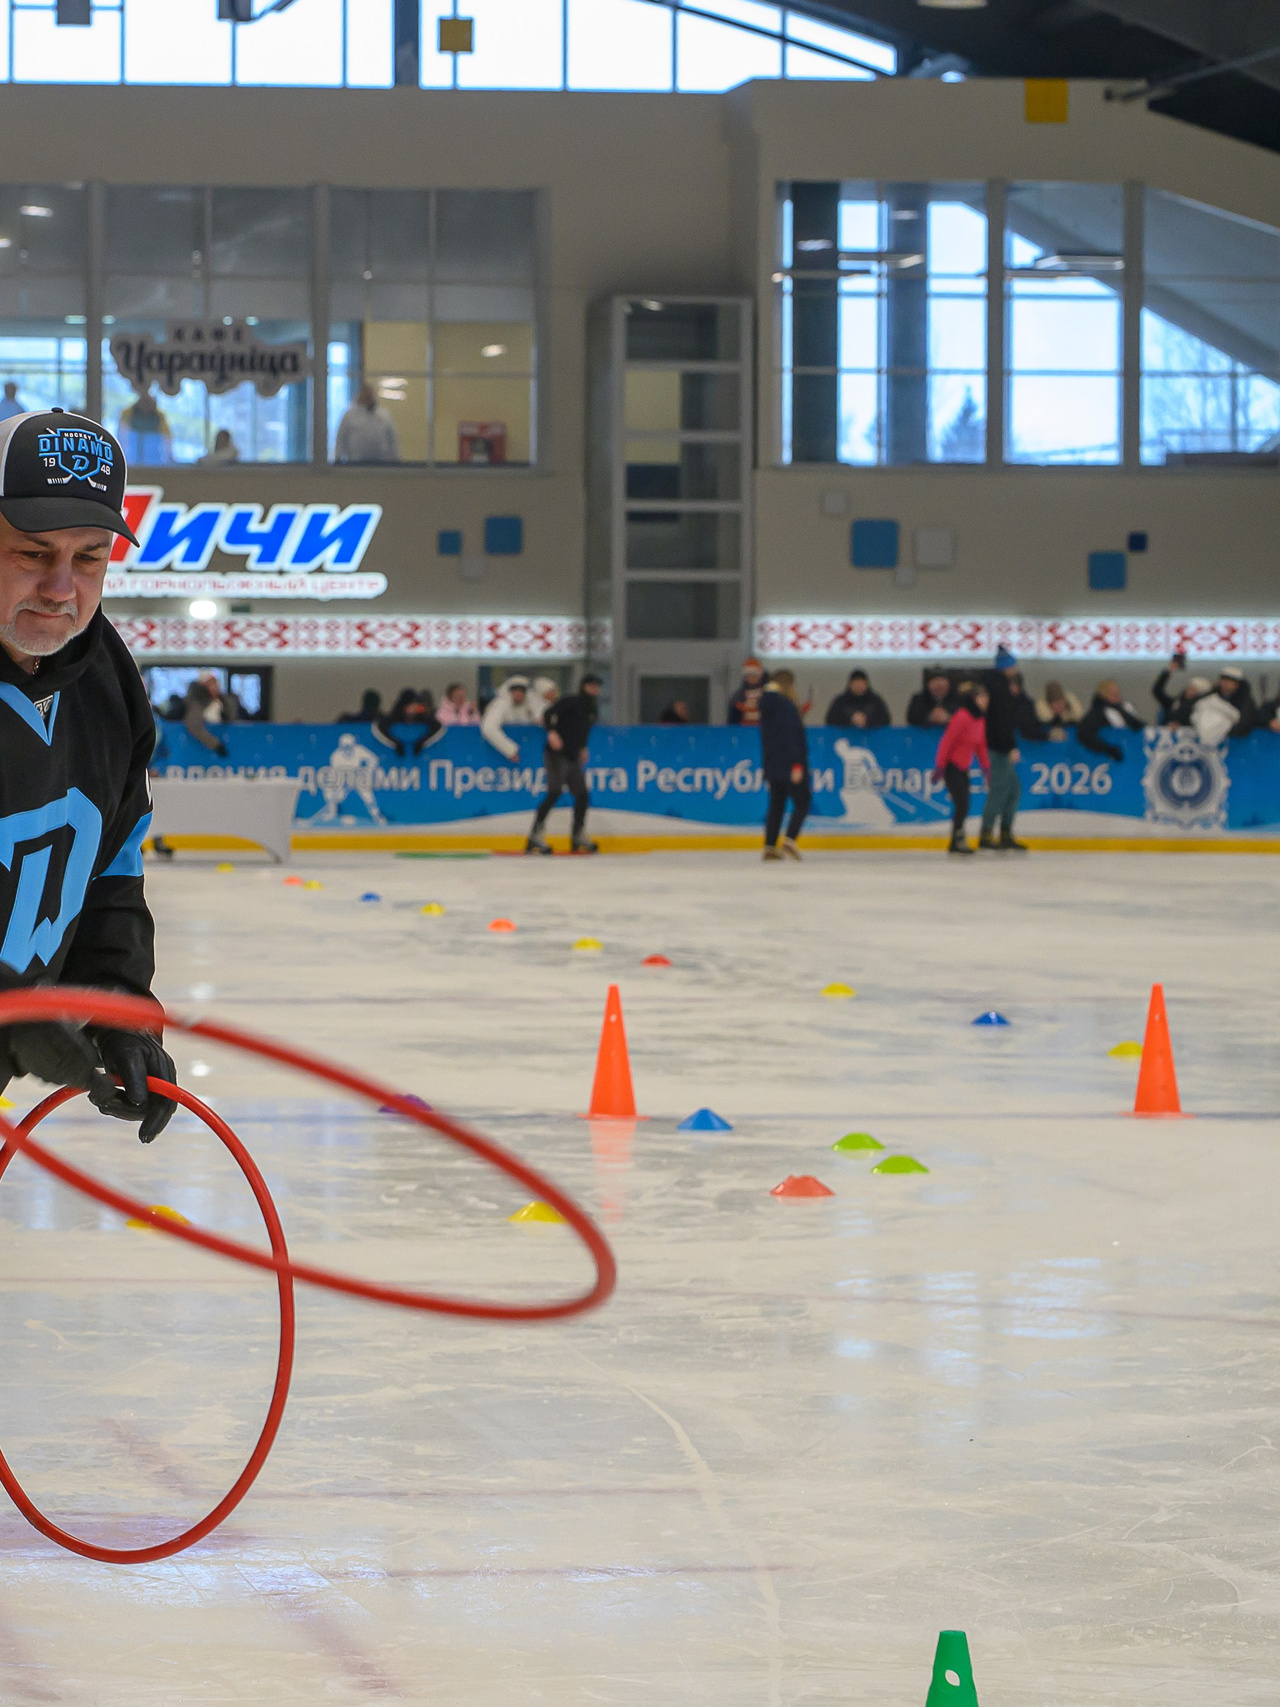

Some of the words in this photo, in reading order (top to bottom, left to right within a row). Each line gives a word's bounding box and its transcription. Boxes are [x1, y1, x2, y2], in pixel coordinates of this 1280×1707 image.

[64, 432, 92, 440] HOCKEY
[39, 438, 113, 460] DINAMO
[43, 457, 56, 467] 19
[100, 464, 111, 475] 48
[429, 760, 628, 799] Президта
[637, 760, 835, 800] Республи
[1030, 762, 1113, 795] 2026
